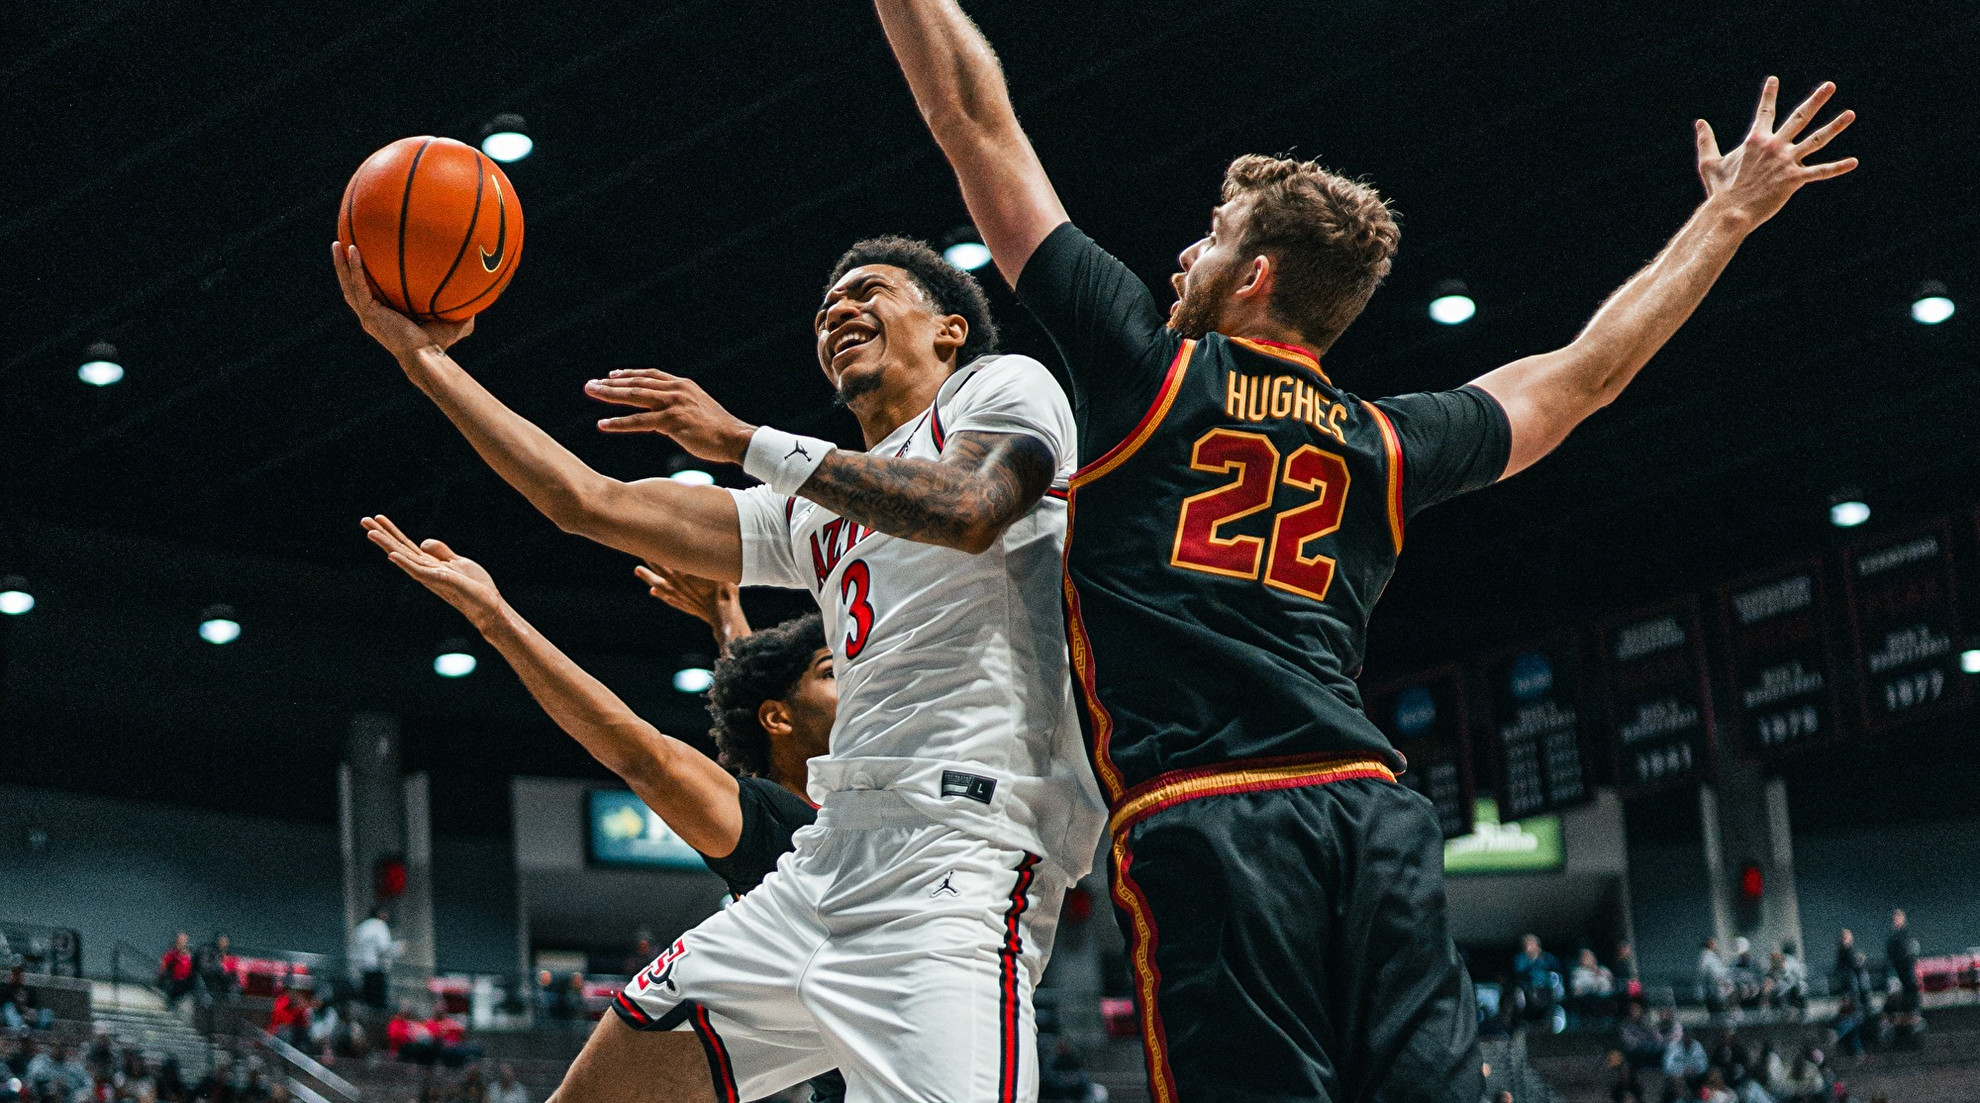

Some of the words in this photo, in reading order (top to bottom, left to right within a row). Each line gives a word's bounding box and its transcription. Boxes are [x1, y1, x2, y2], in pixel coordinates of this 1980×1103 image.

[1225, 369, 1348, 445] HUGHES
[1170, 427, 1352, 602] 22
[810, 516, 876, 594] AZT
[841, 558, 876, 660] 3
[977, 782, 984, 794] L
